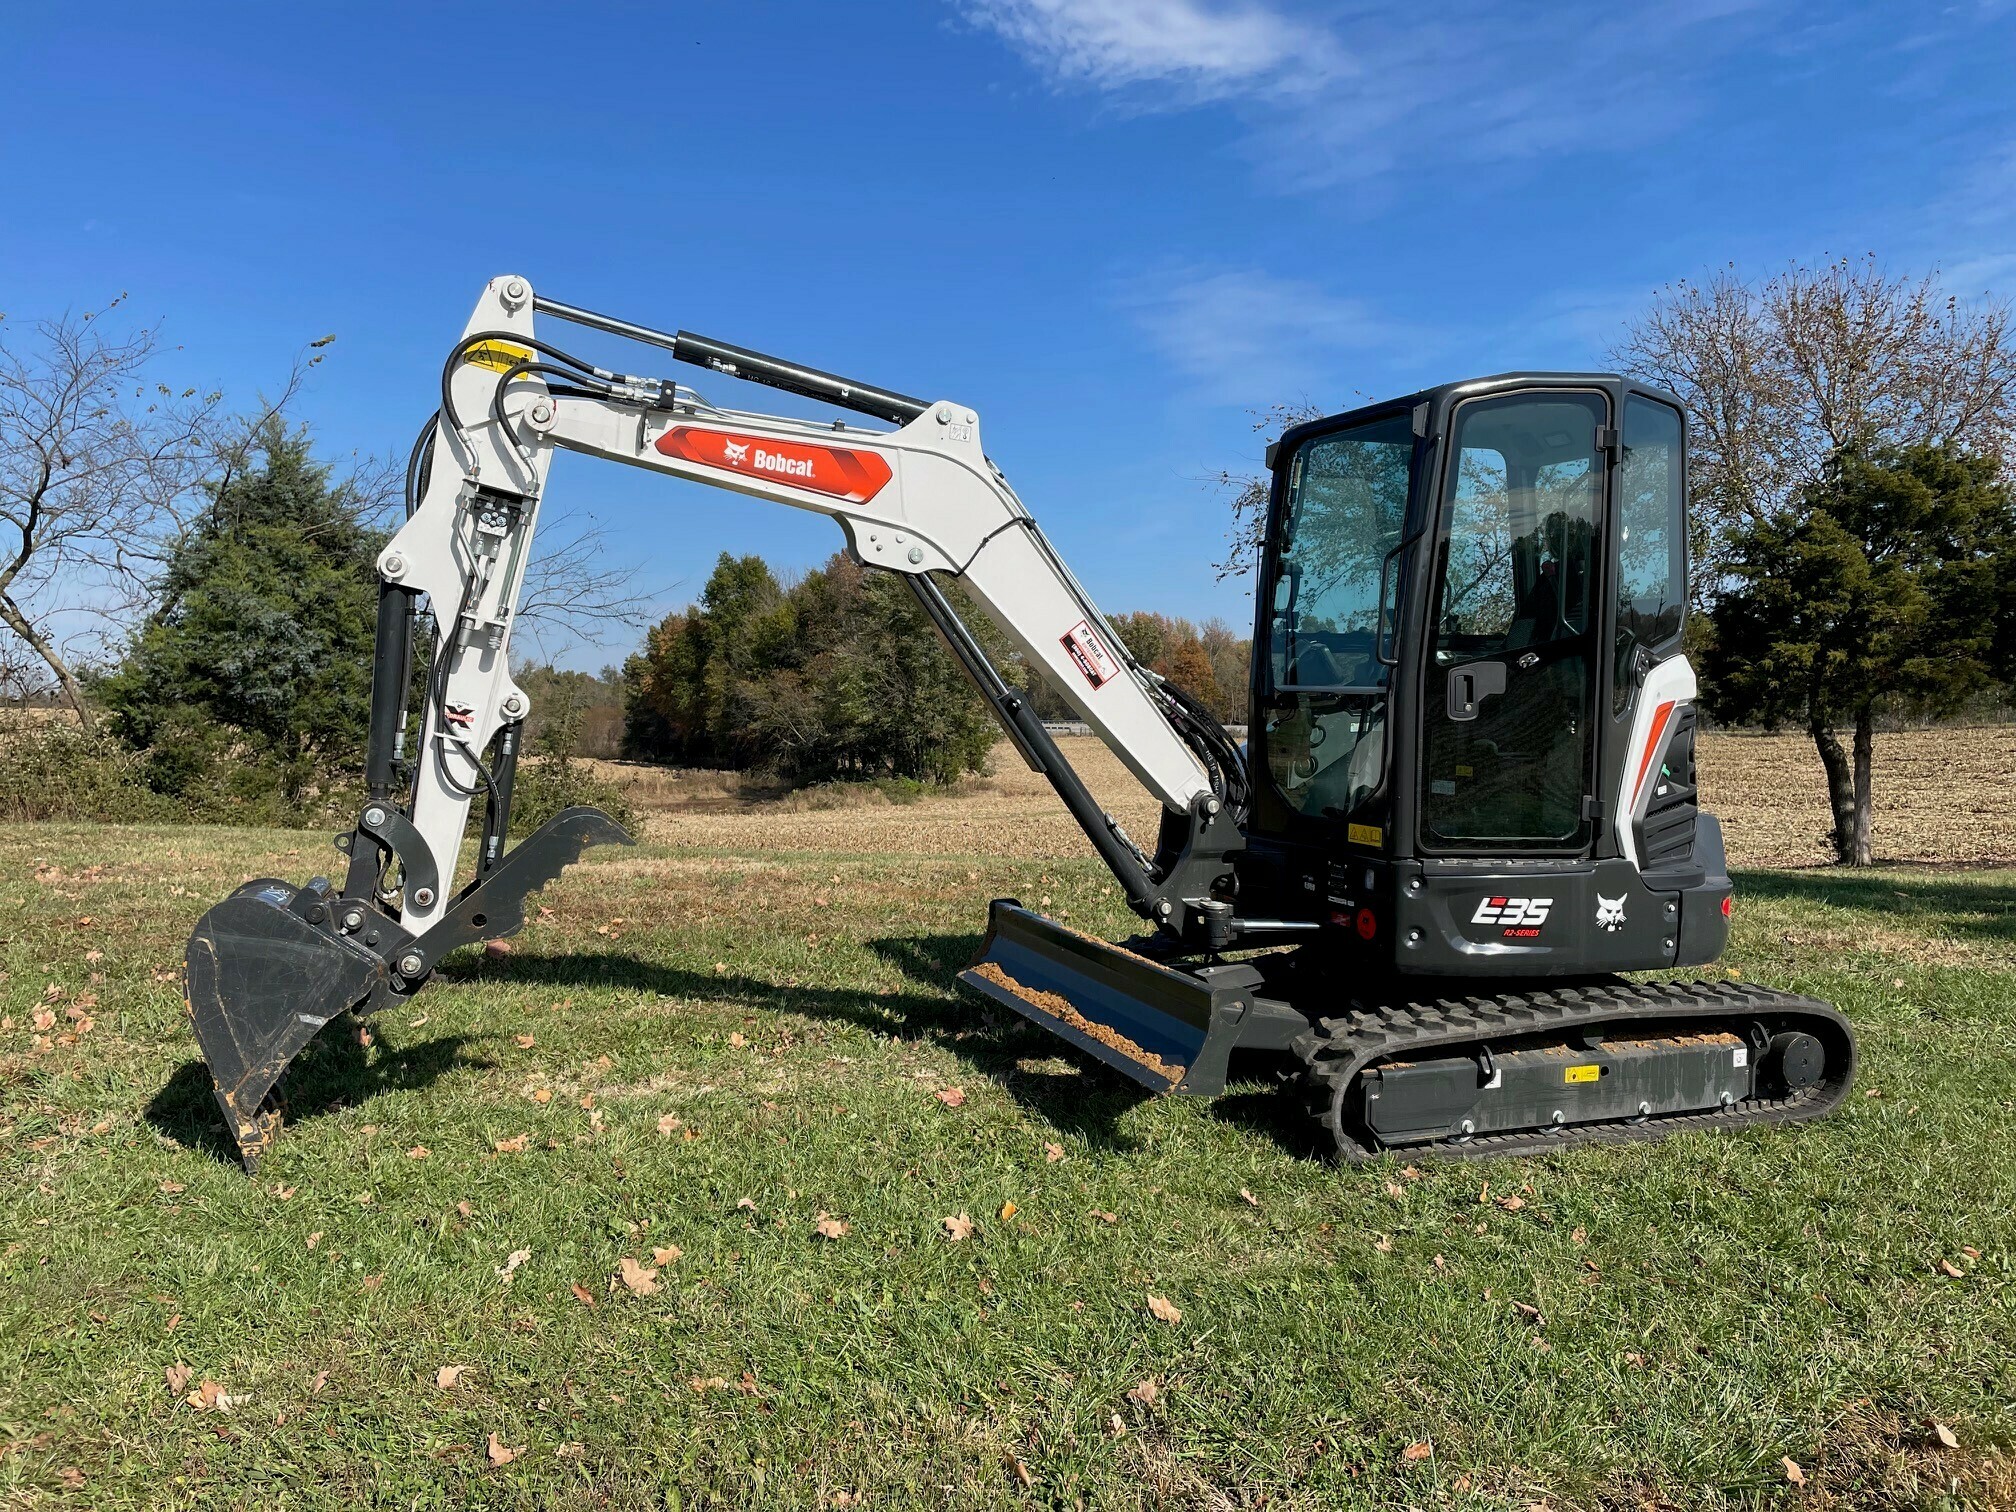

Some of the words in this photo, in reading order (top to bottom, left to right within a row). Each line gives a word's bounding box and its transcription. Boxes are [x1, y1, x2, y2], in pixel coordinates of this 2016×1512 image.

[754, 449, 814, 477] Bobcat
[1086, 638, 1104, 660] Bobcat
[1470, 897, 1554, 926] E35
[1503, 929, 1540, 937] R2-SERIES
